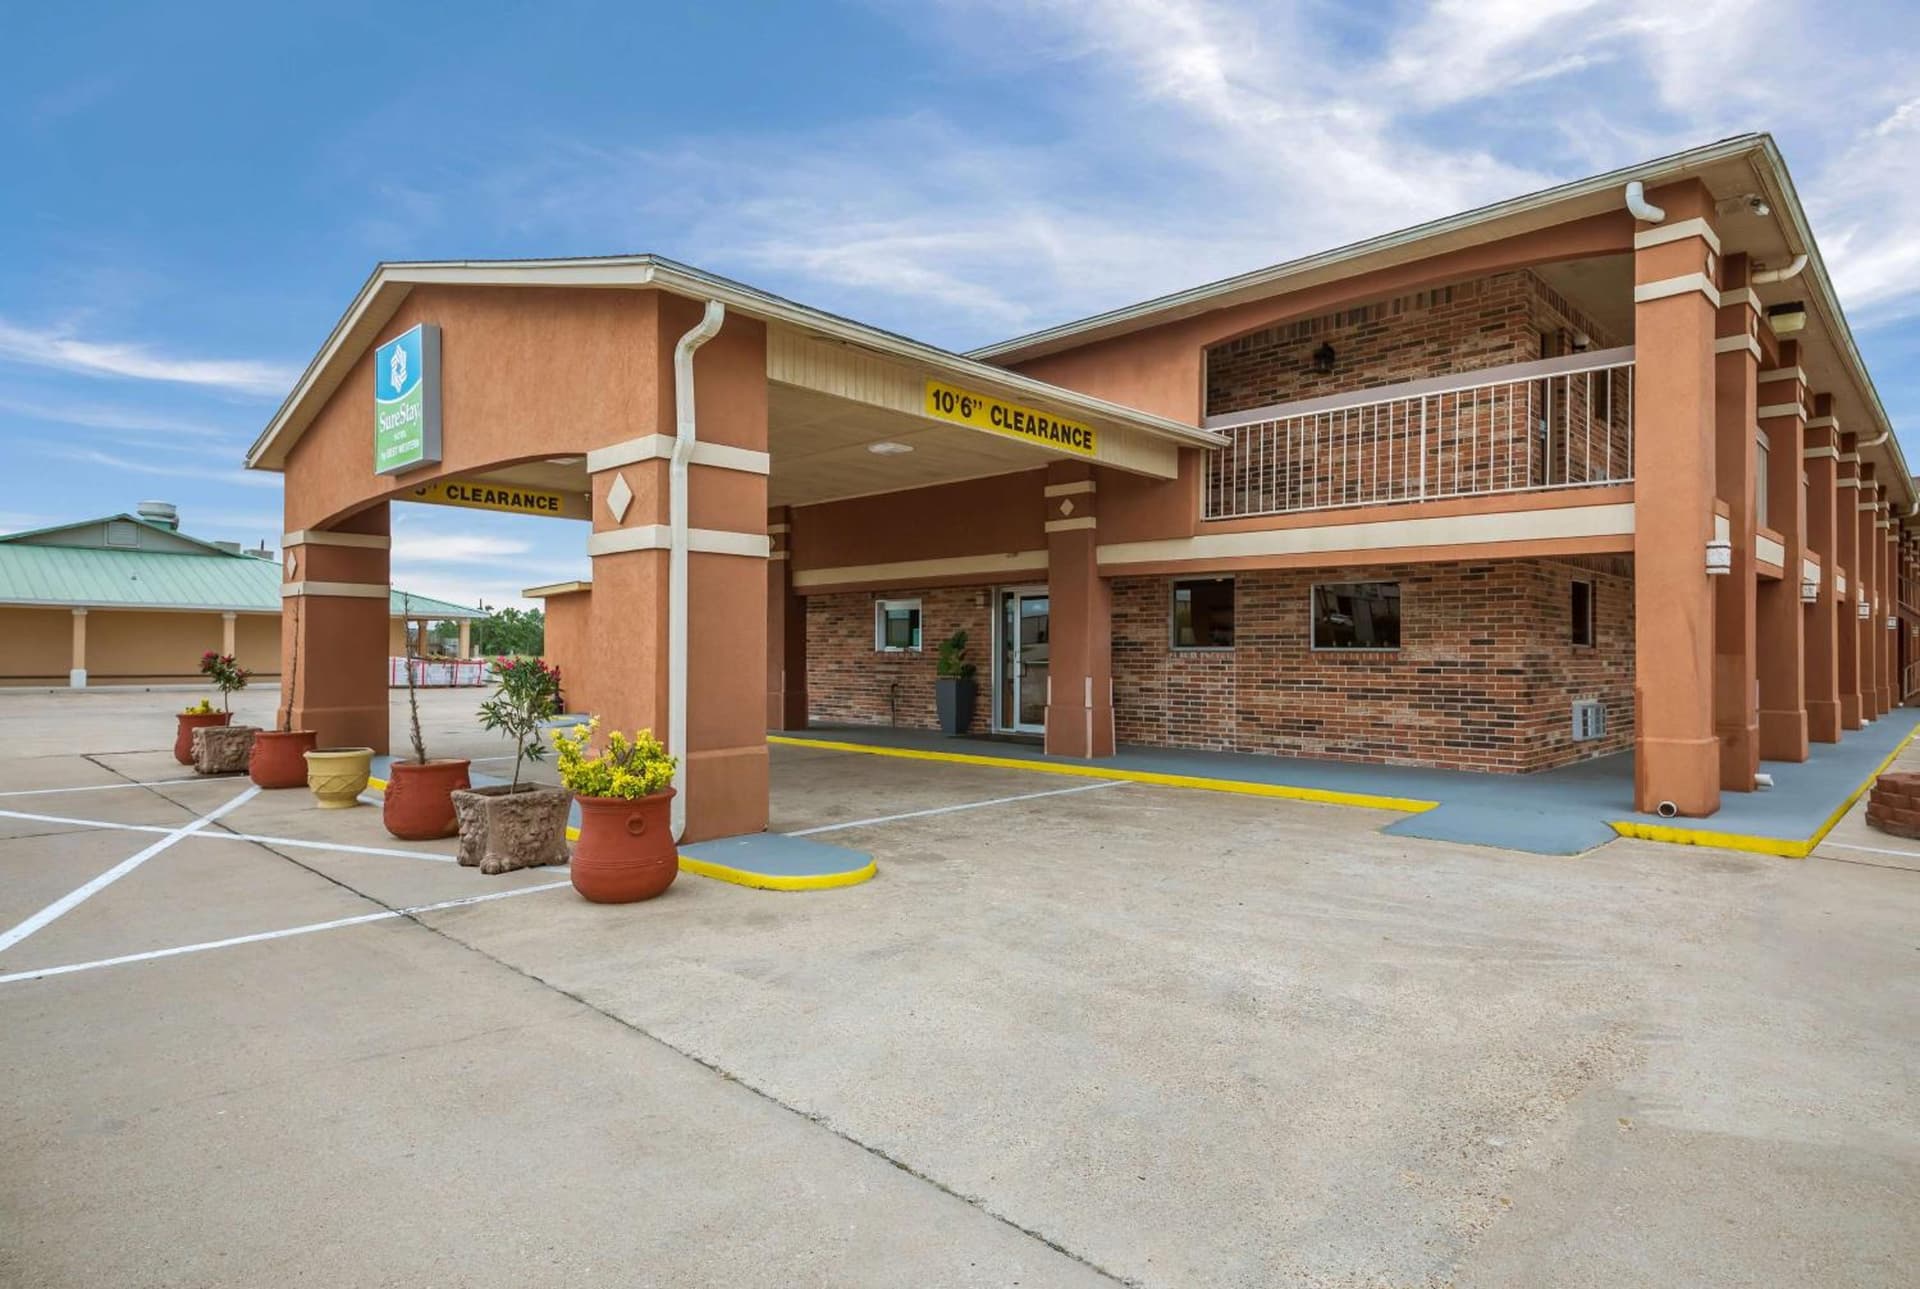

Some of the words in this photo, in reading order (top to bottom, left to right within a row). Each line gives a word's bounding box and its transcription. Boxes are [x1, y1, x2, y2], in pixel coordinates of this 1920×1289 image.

[379, 402, 419, 432] SureStay
[990, 405, 1093, 450] CLEARANCE
[446, 485, 559, 511] CLEARANCE
